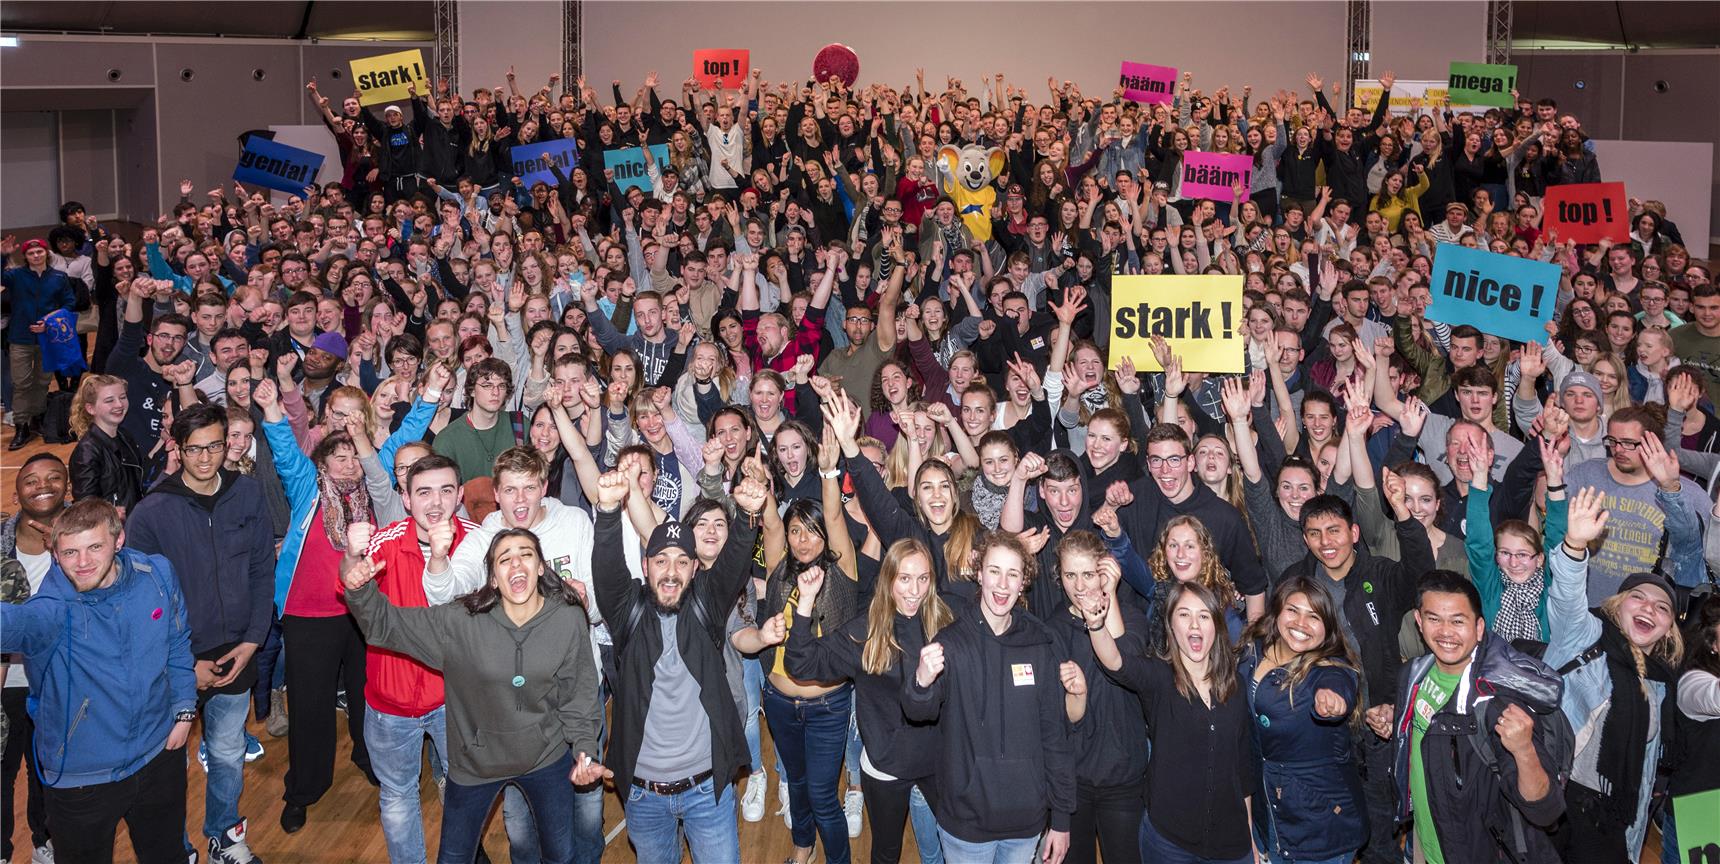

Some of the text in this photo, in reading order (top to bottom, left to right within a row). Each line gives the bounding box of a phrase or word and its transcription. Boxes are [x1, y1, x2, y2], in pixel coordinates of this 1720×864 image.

[359, 63, 422, 90] stark !
[704, 60, 739, 77] top !
[1451, 74, 1503, 93] mega
[240, 150, 308, 183] genial
[513, 151, 570, 176] genal
[1184, 164, 1239, 187] bääm
[1559, 198, 1613, 225] top !
[1444, 270, 1544, 317] nice !
[1115, 302, 1232, 339] stark !
[1620, 497, 1666, 532] SUPERIO
